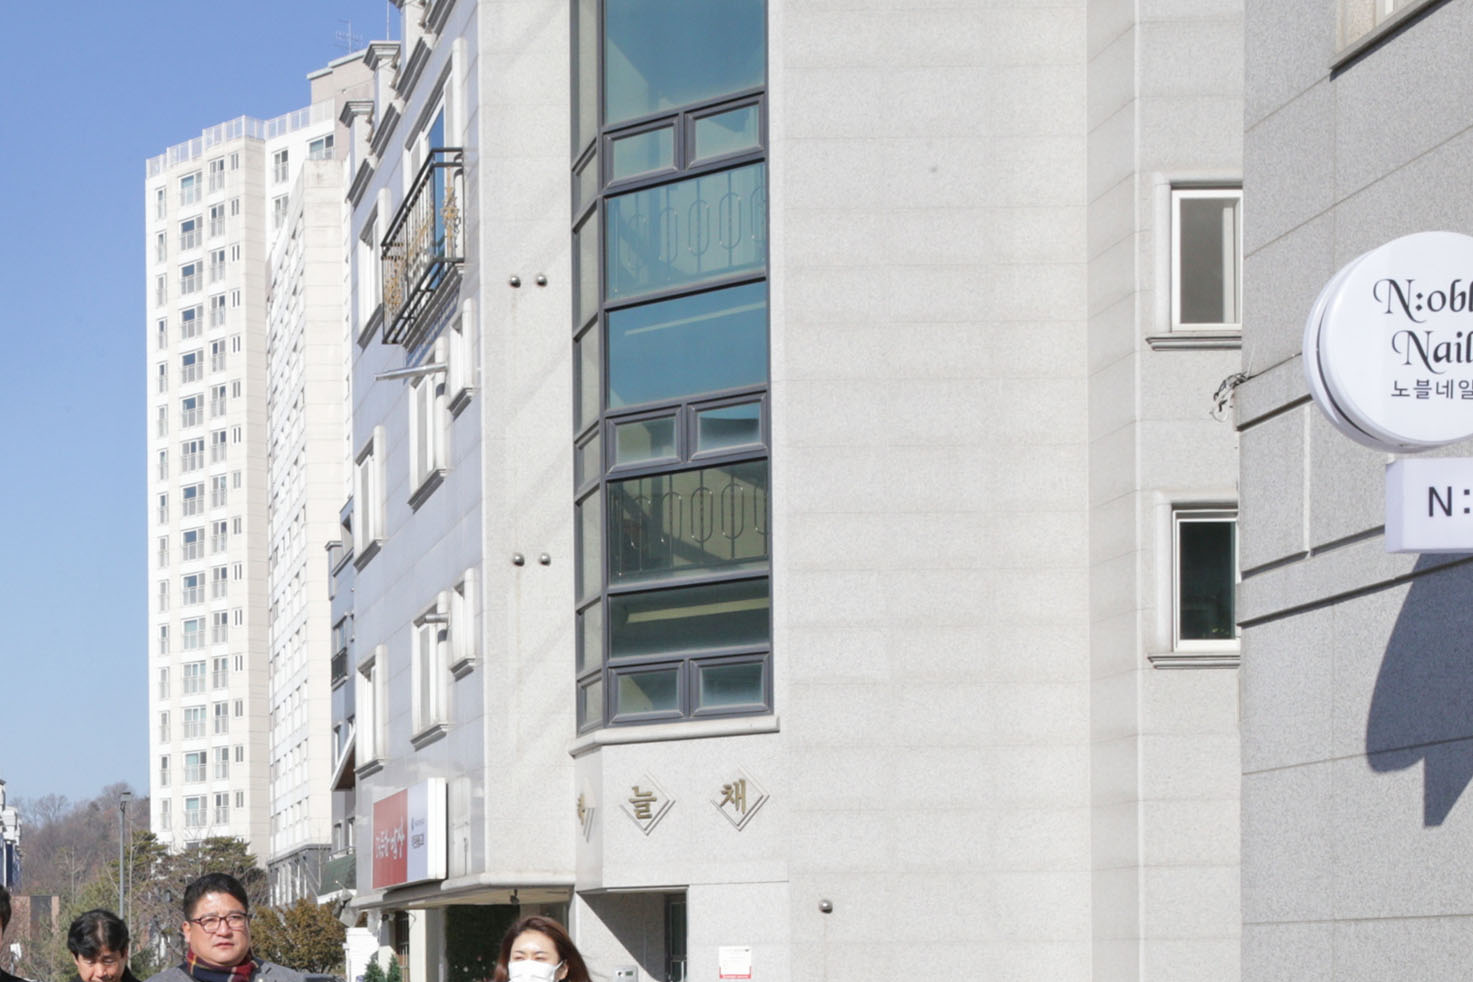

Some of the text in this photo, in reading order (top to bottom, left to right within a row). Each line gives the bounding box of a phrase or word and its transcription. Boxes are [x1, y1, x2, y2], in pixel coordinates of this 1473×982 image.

[1391, 329, 1473, 375] Nail
[1391, 379, 1473, 400] 노블네일
[719, 778, 747, 815] 채
